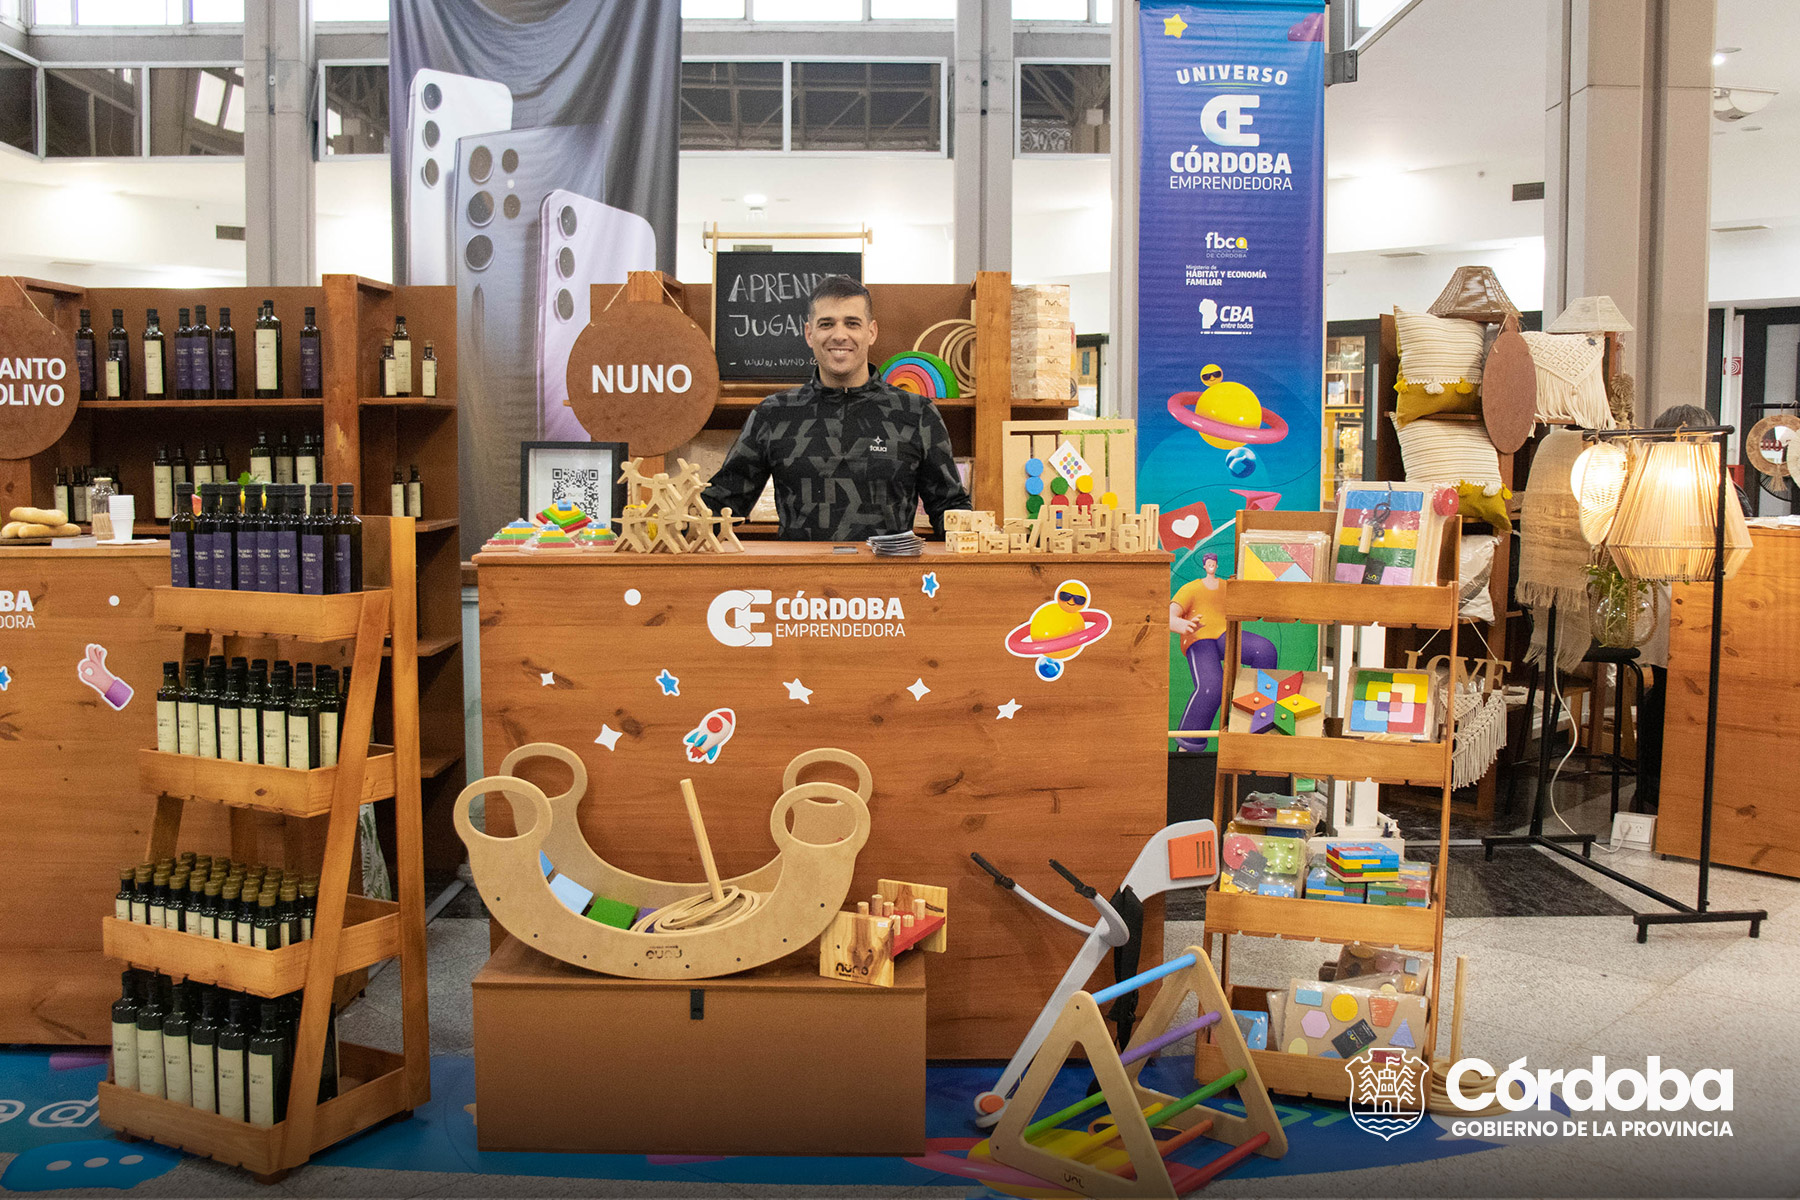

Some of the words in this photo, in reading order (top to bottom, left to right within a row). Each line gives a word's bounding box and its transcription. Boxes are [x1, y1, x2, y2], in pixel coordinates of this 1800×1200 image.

[1176, 65, 1288, 86] UNIVERSO
[1170, 145, 1292, 174] CÓRDOBA
[1169, 175, 1293, 191] EMPRENDEDORA
[1186, 268, 1219, 278] HÁBITAT
[1227, 269, 1266, 279] ECONOMÍA
[728, 272, 852, 303] APREN
[1220, 306, 1254, 322] CBA
[592, 364, 692, 394] NUNO
[775, 590, 905, 621] CÓRDOBA
[775, 623, 906, 638] EMPRENDEDORA
